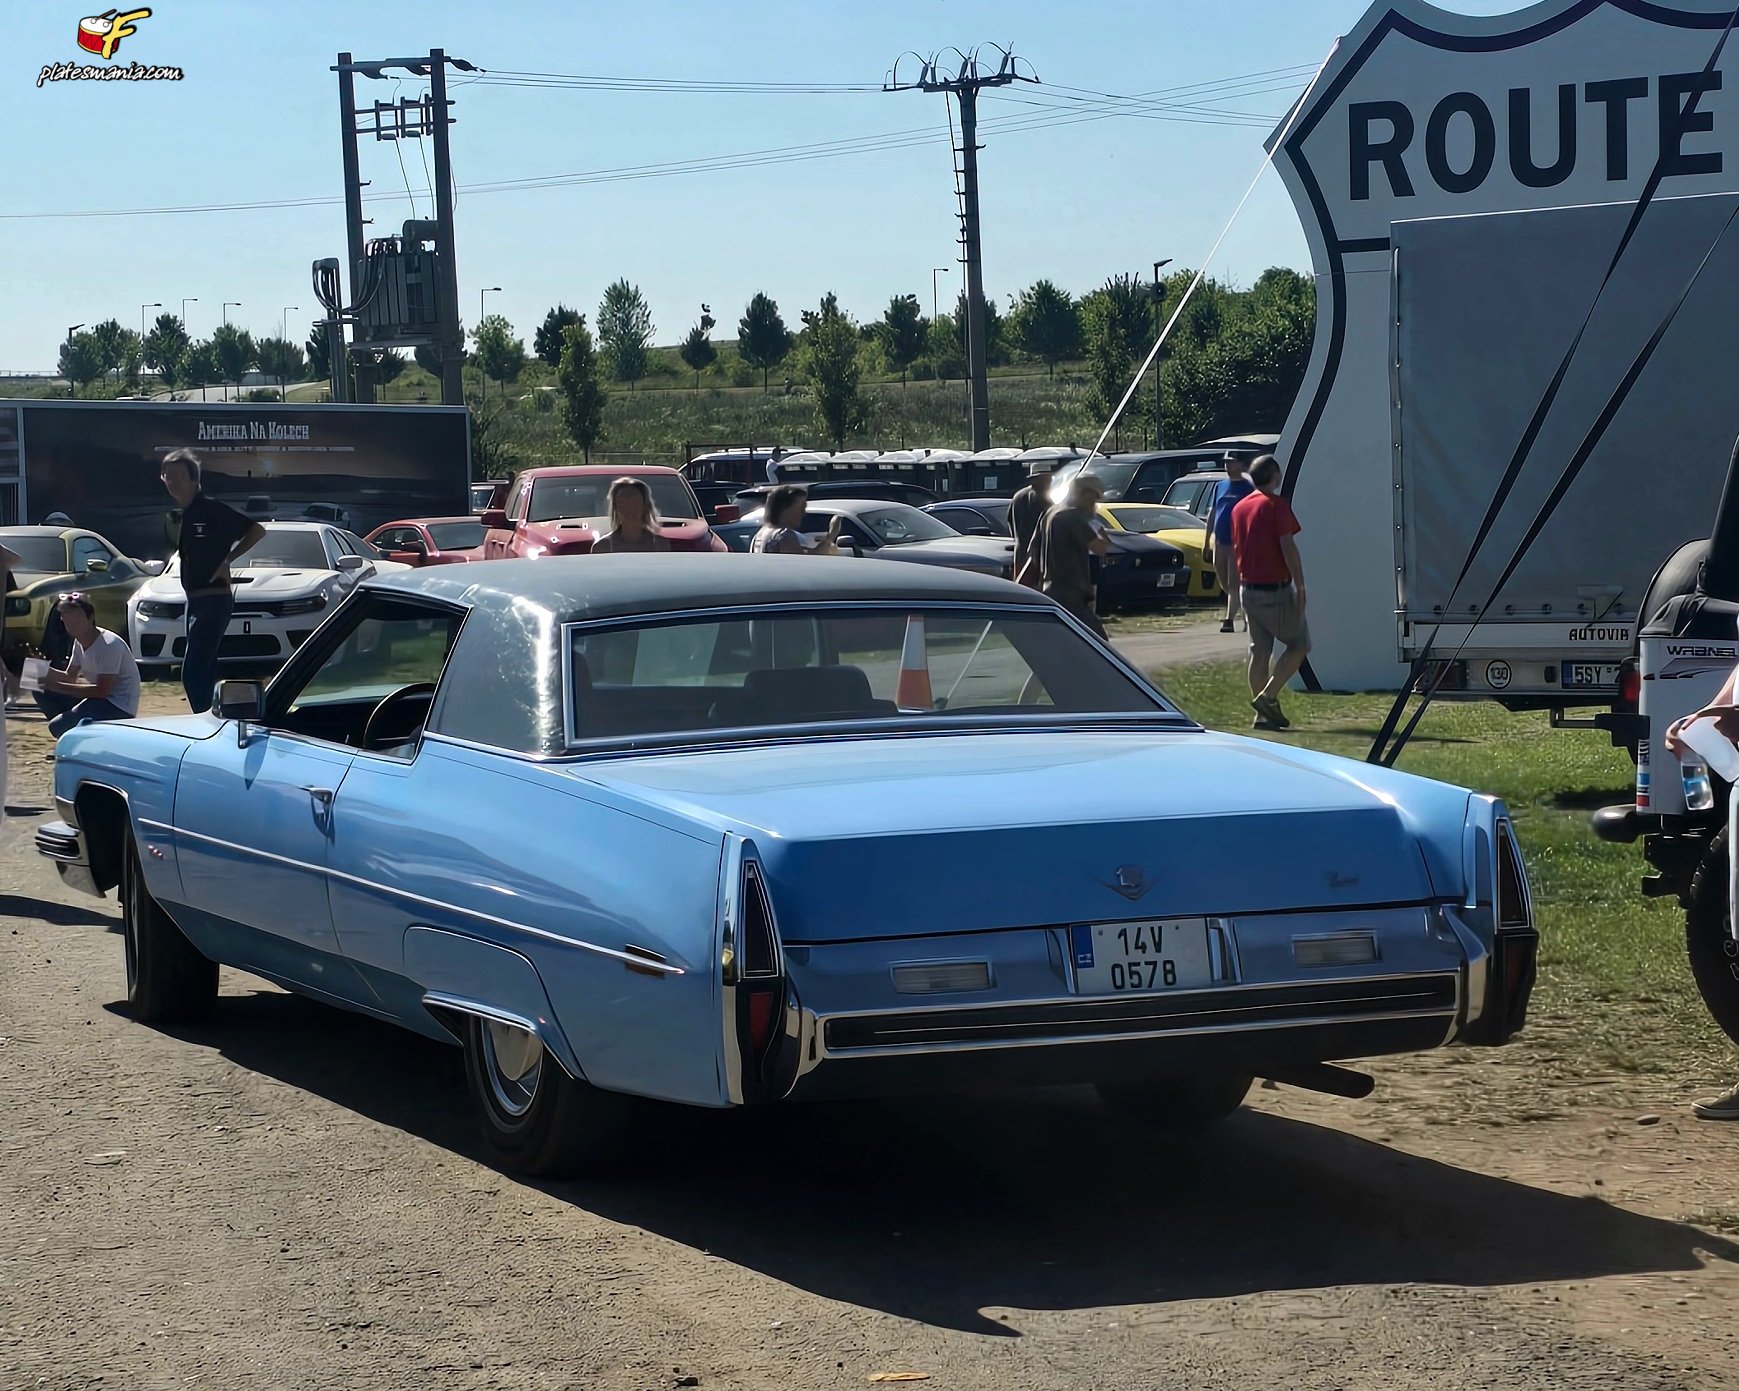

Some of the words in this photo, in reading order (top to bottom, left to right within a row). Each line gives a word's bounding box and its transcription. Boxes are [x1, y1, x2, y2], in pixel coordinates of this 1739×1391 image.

[1348, 69, 1724, 201] ROUTE
[1574, 665, 1602, 684] 5SY
[1117, 925, 1163, 956] 14V
[1111, 959, 1177, 990] 0578
